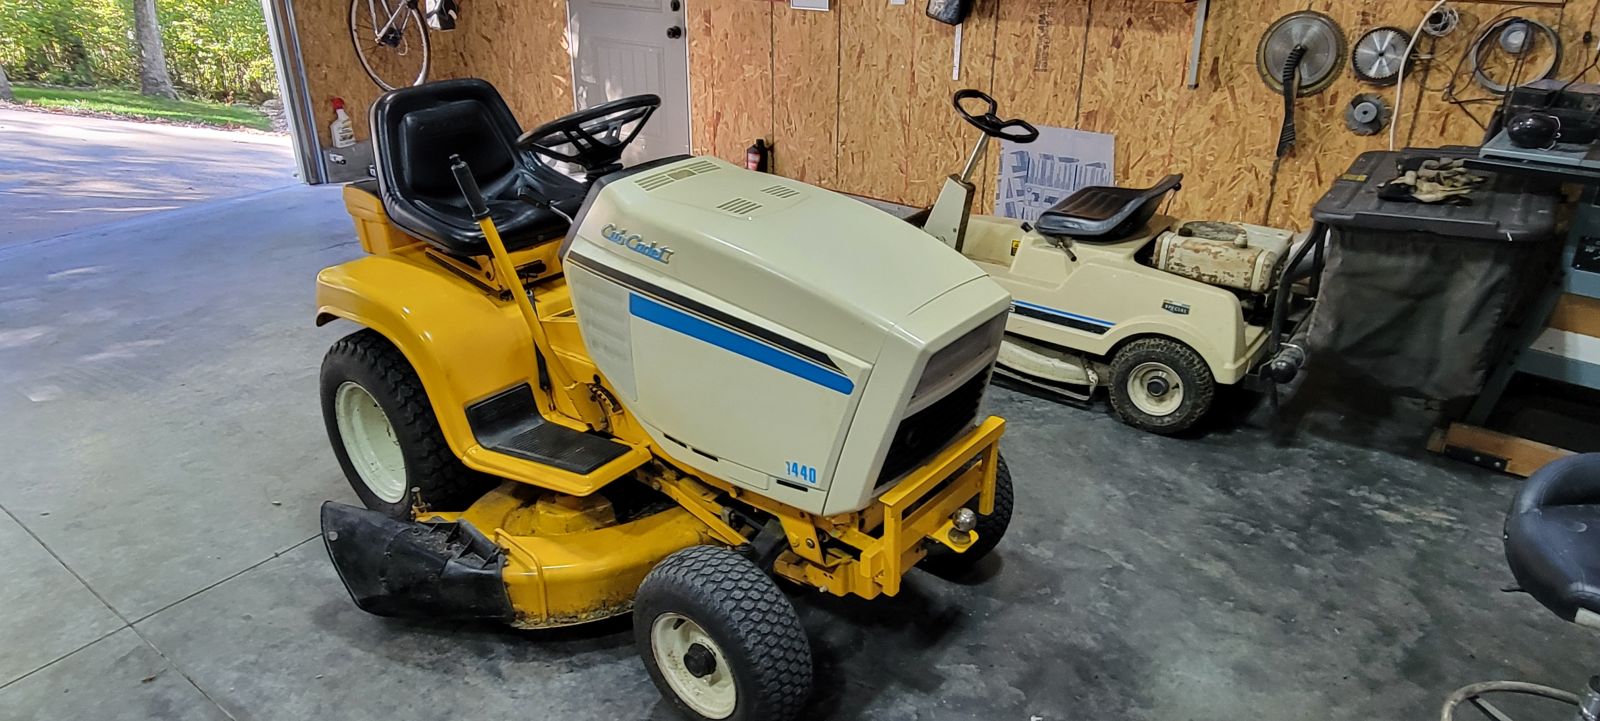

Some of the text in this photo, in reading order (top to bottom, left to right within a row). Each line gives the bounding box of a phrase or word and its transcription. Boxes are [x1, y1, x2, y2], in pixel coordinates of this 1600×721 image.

[601, 223, 674, 264] Cub Cadet
[785, 461, 817, 484] 1440
